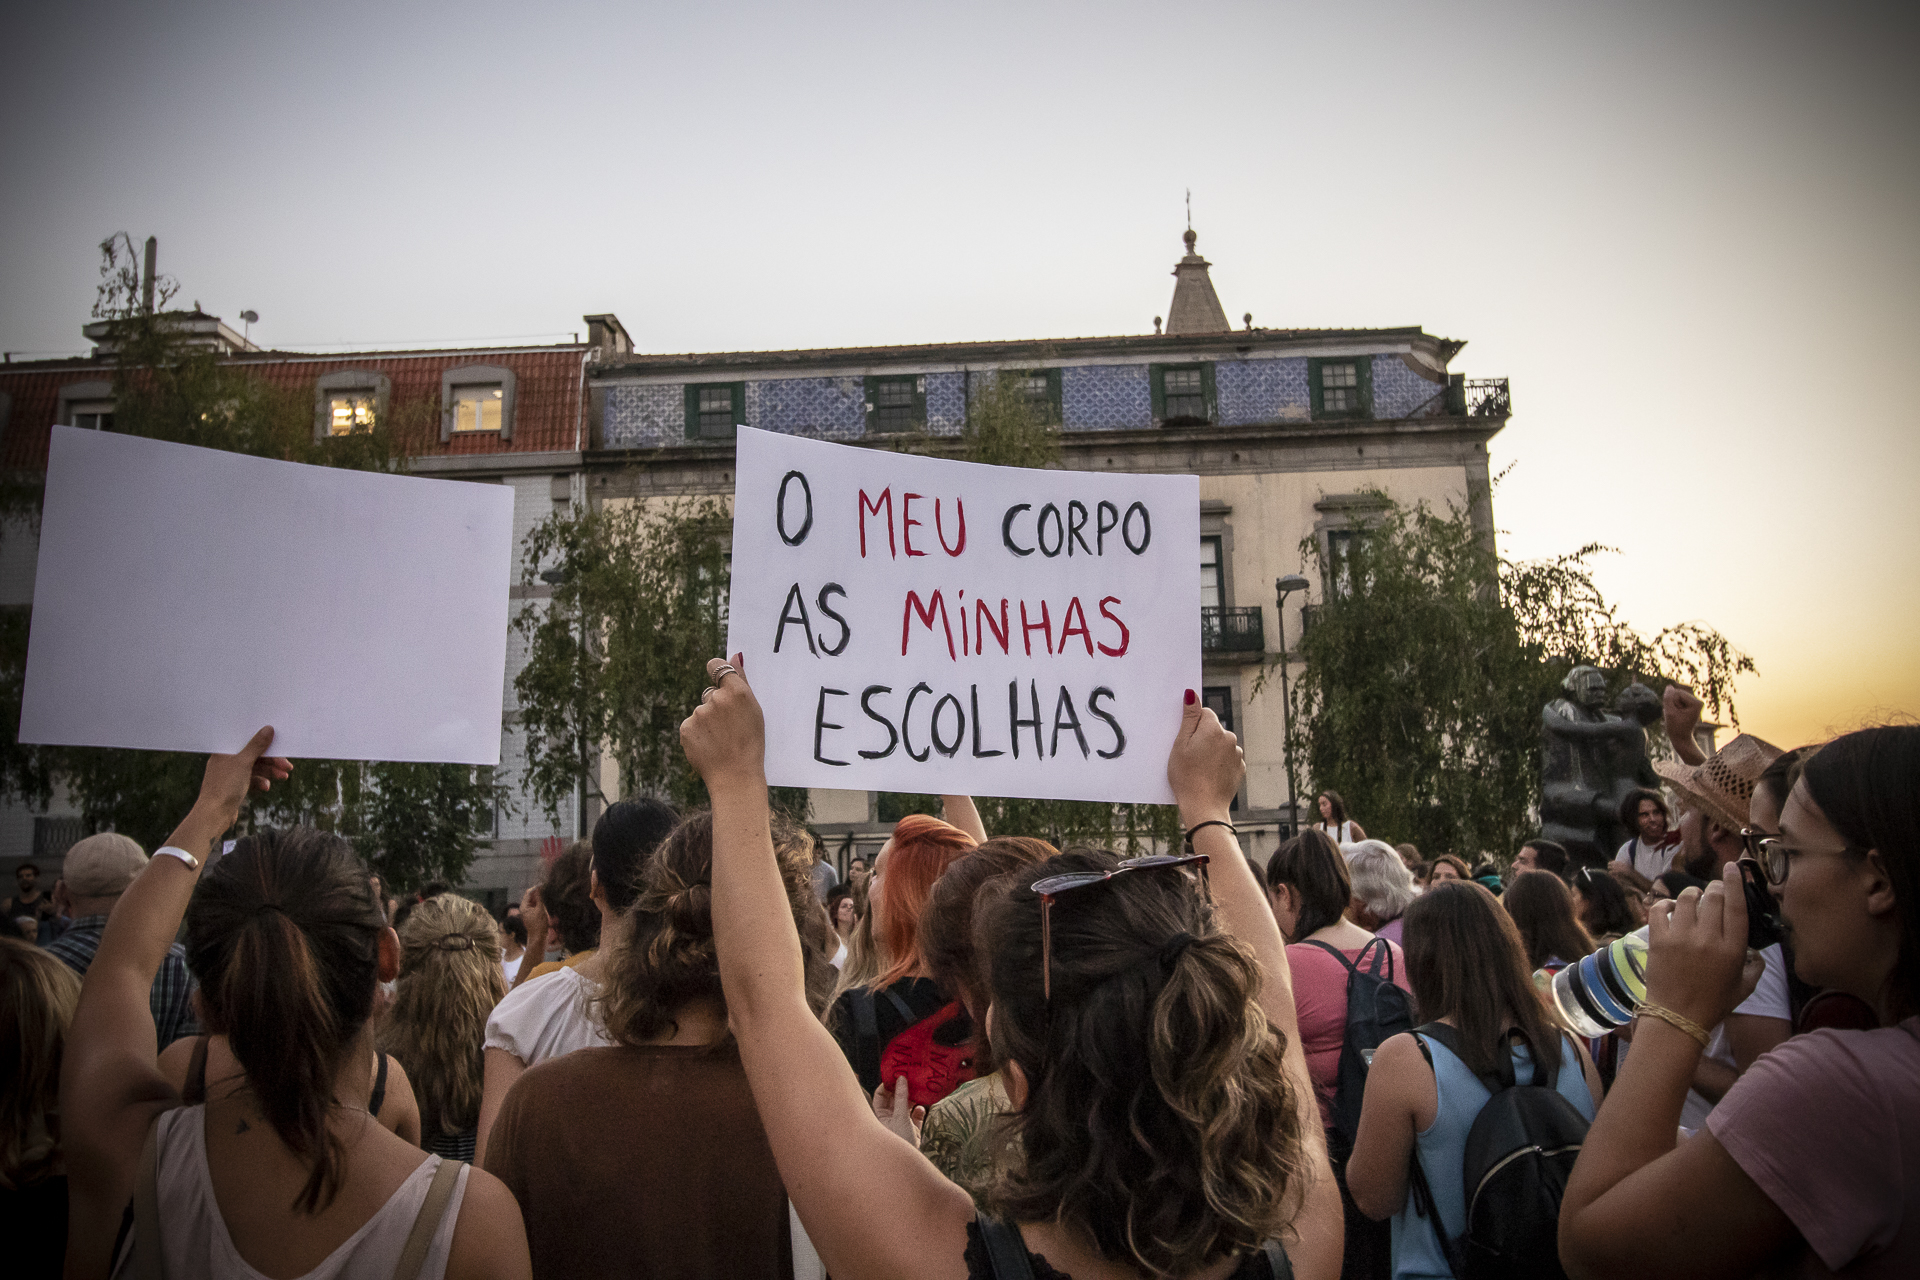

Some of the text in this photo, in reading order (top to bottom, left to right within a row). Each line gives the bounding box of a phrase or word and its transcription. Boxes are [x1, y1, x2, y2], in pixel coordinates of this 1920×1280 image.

[776, 469, 1152, 561] O MEU CORPO
[773, 581, 852, 660] AS
[813, 677, 1128, 767] ESCOLHAS
[925, 1051, 950, 1094] NÃO
